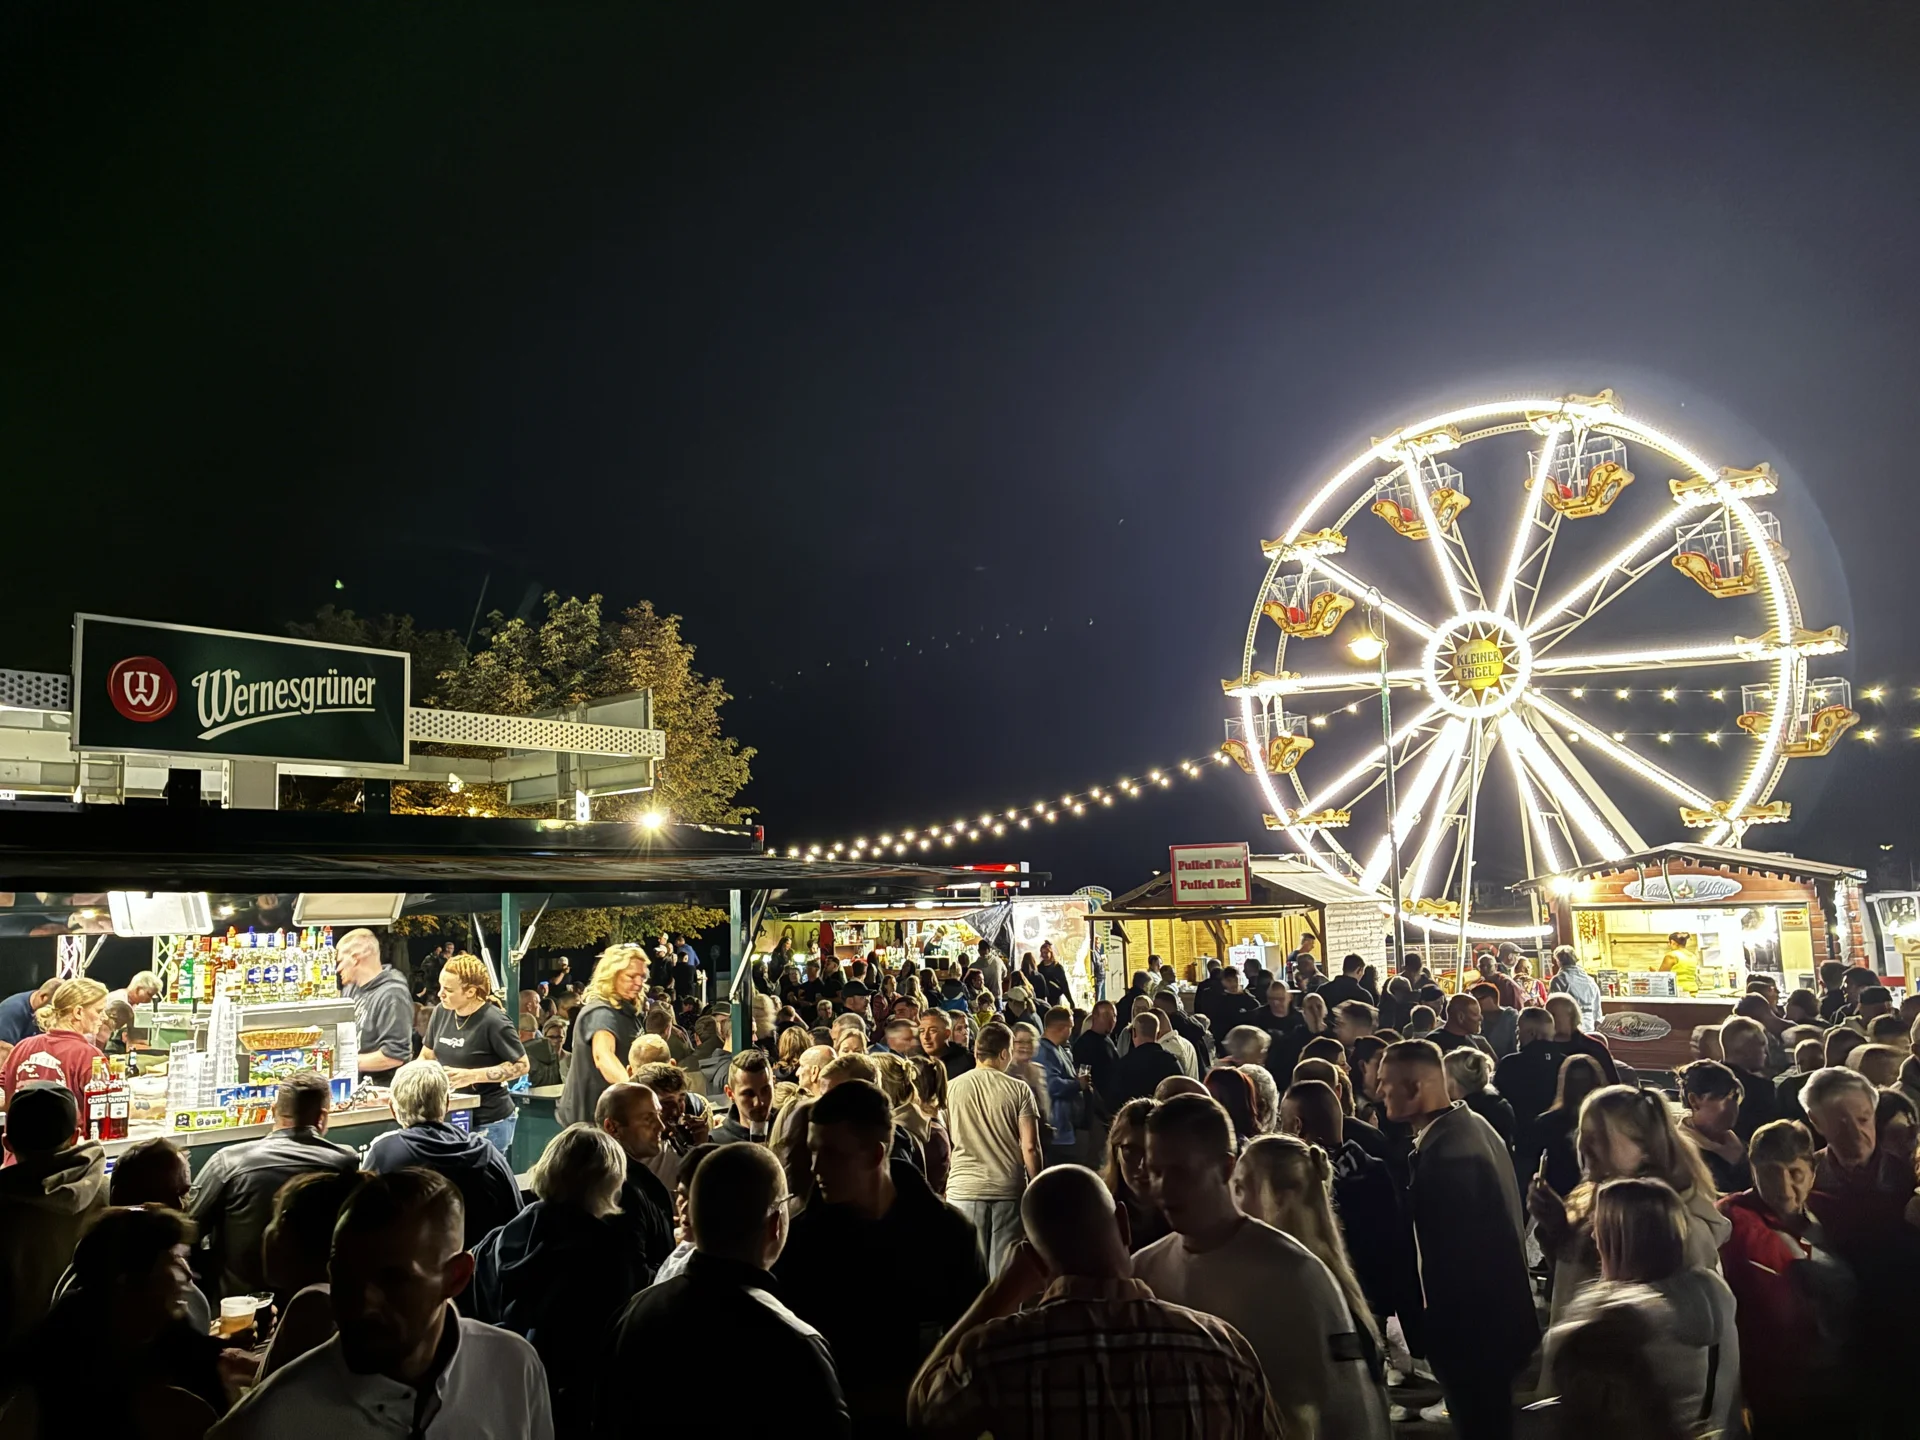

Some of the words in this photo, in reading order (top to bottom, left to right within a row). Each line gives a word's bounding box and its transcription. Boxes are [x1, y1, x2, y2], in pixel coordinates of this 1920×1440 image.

[1457, 651, 1500, 666] KLEINER
[1461, 665, 1495, 679] ENGEL
[191, 668, 376, 728] Wernesgrüner
[1178, 860, 1212, 870] Pulled
[1180, 880, 1215, 890] Pulled
[1217, 879, 1242, 889] Beef
